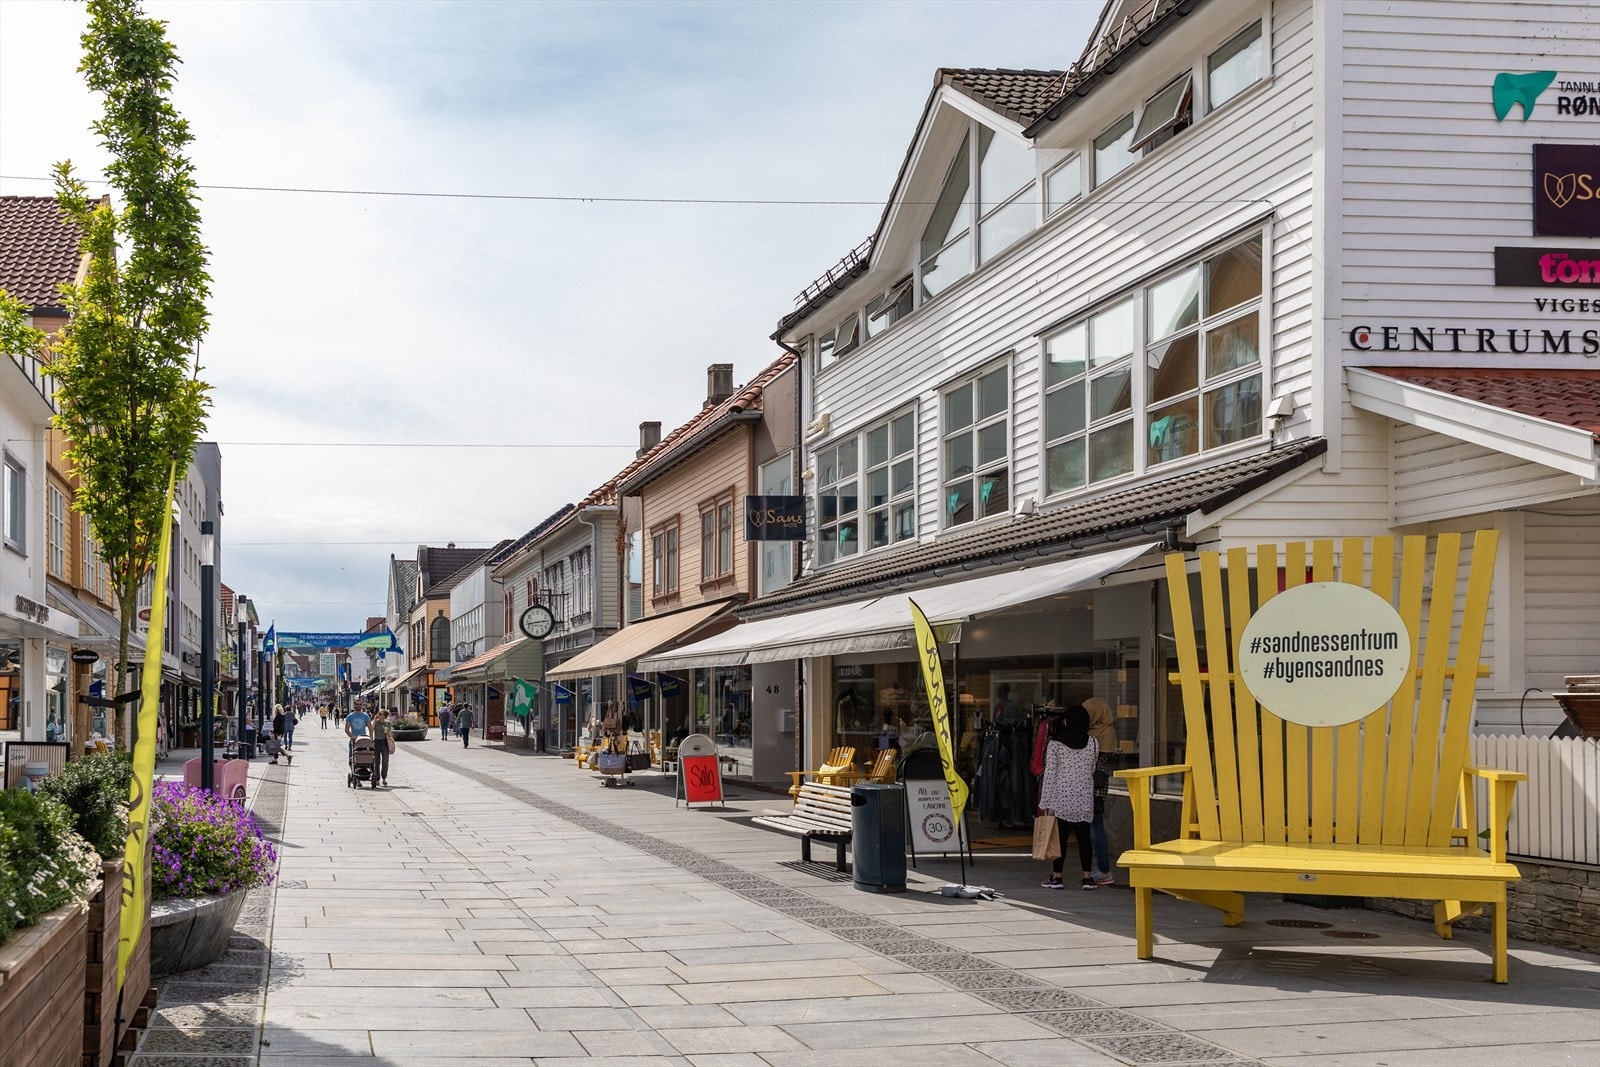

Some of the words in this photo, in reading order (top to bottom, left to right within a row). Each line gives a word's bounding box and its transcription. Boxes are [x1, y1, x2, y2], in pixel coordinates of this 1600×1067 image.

[1349, 325, 1600, 354] CENTRUMS
[766, 509, 803, 524] Sans
[1250, 628, 1398, 654] #sandnessentrum
[1263, 655, 1384, 684] #byensandnes
[690, 764, 716, 794] Salg
